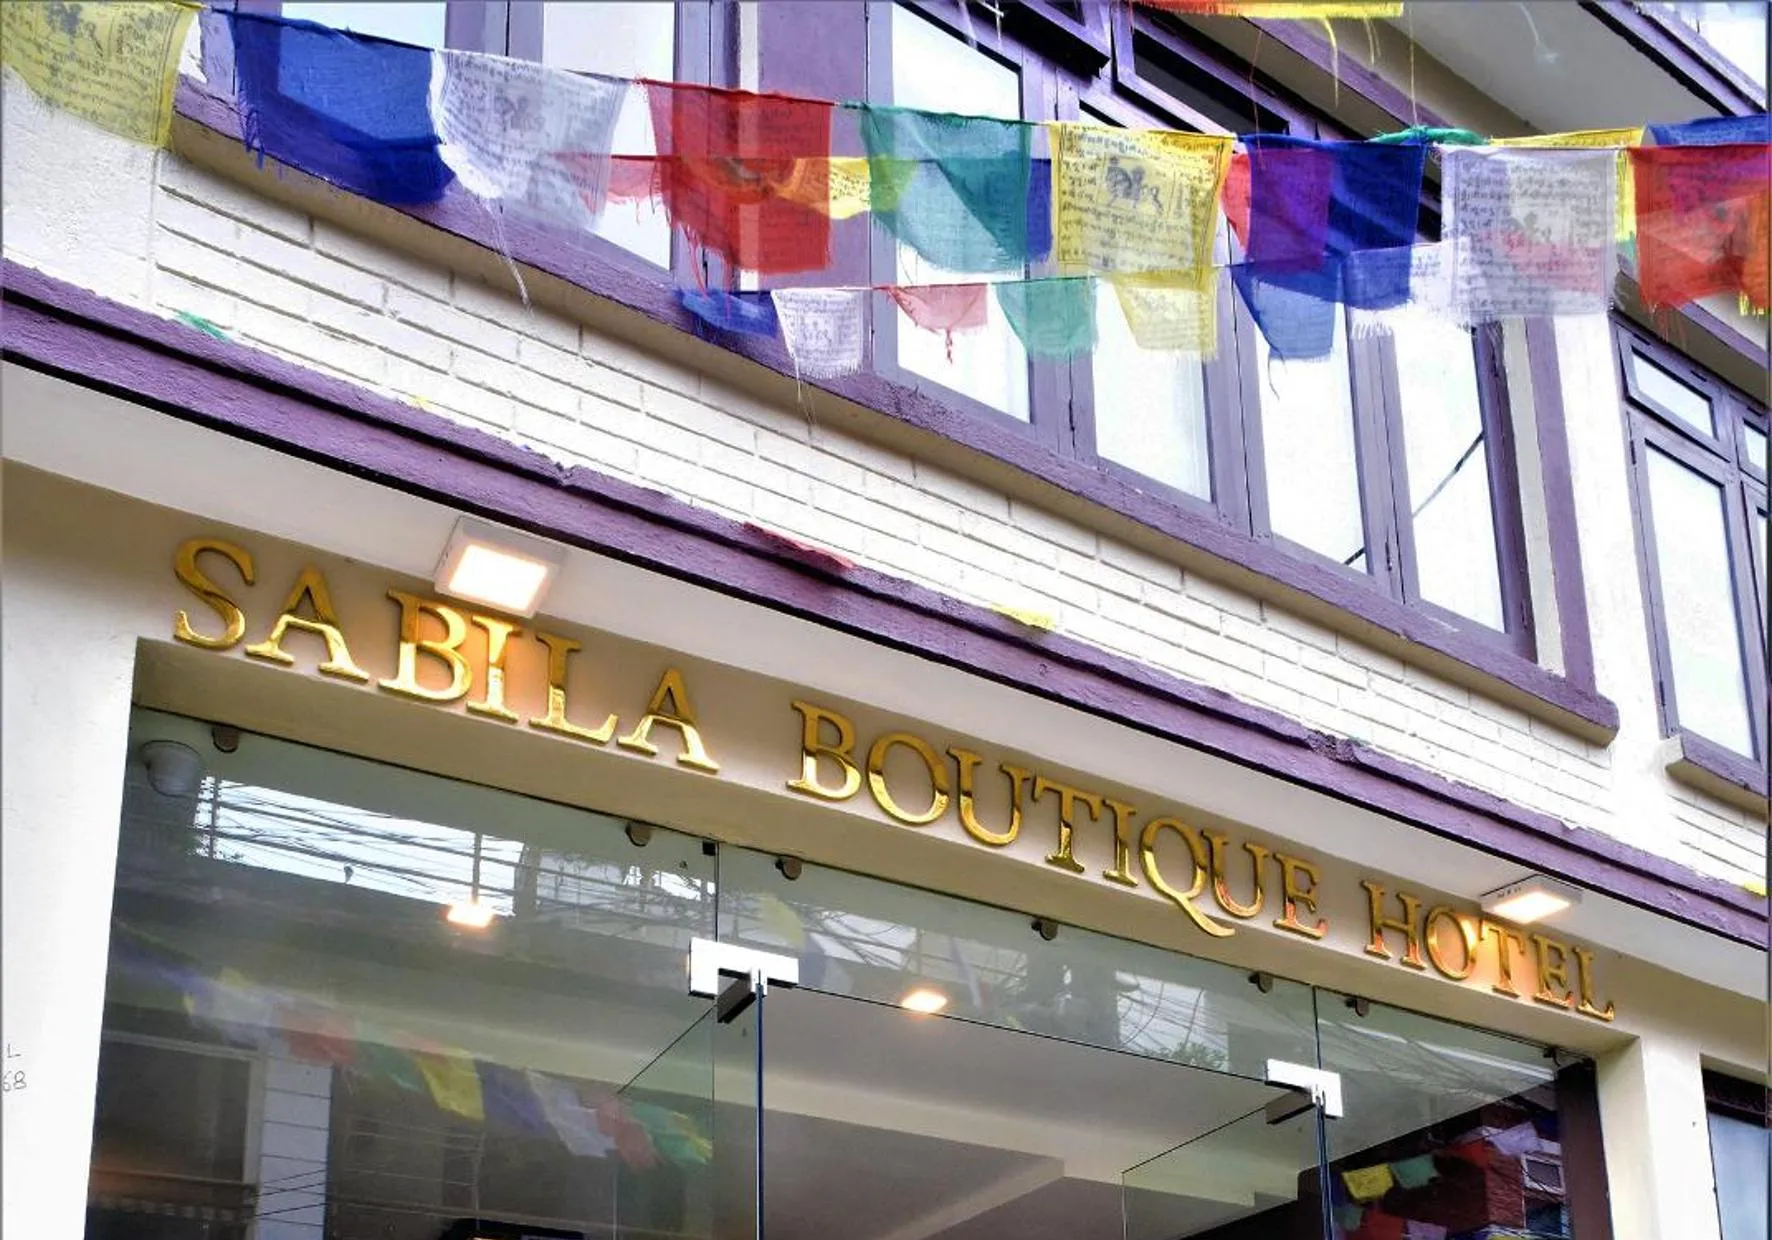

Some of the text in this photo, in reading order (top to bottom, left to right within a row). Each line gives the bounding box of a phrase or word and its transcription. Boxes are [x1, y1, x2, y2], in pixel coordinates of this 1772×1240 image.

[173, 536, 1616, 1022] SABILA BOUTIQUE HOTEL
